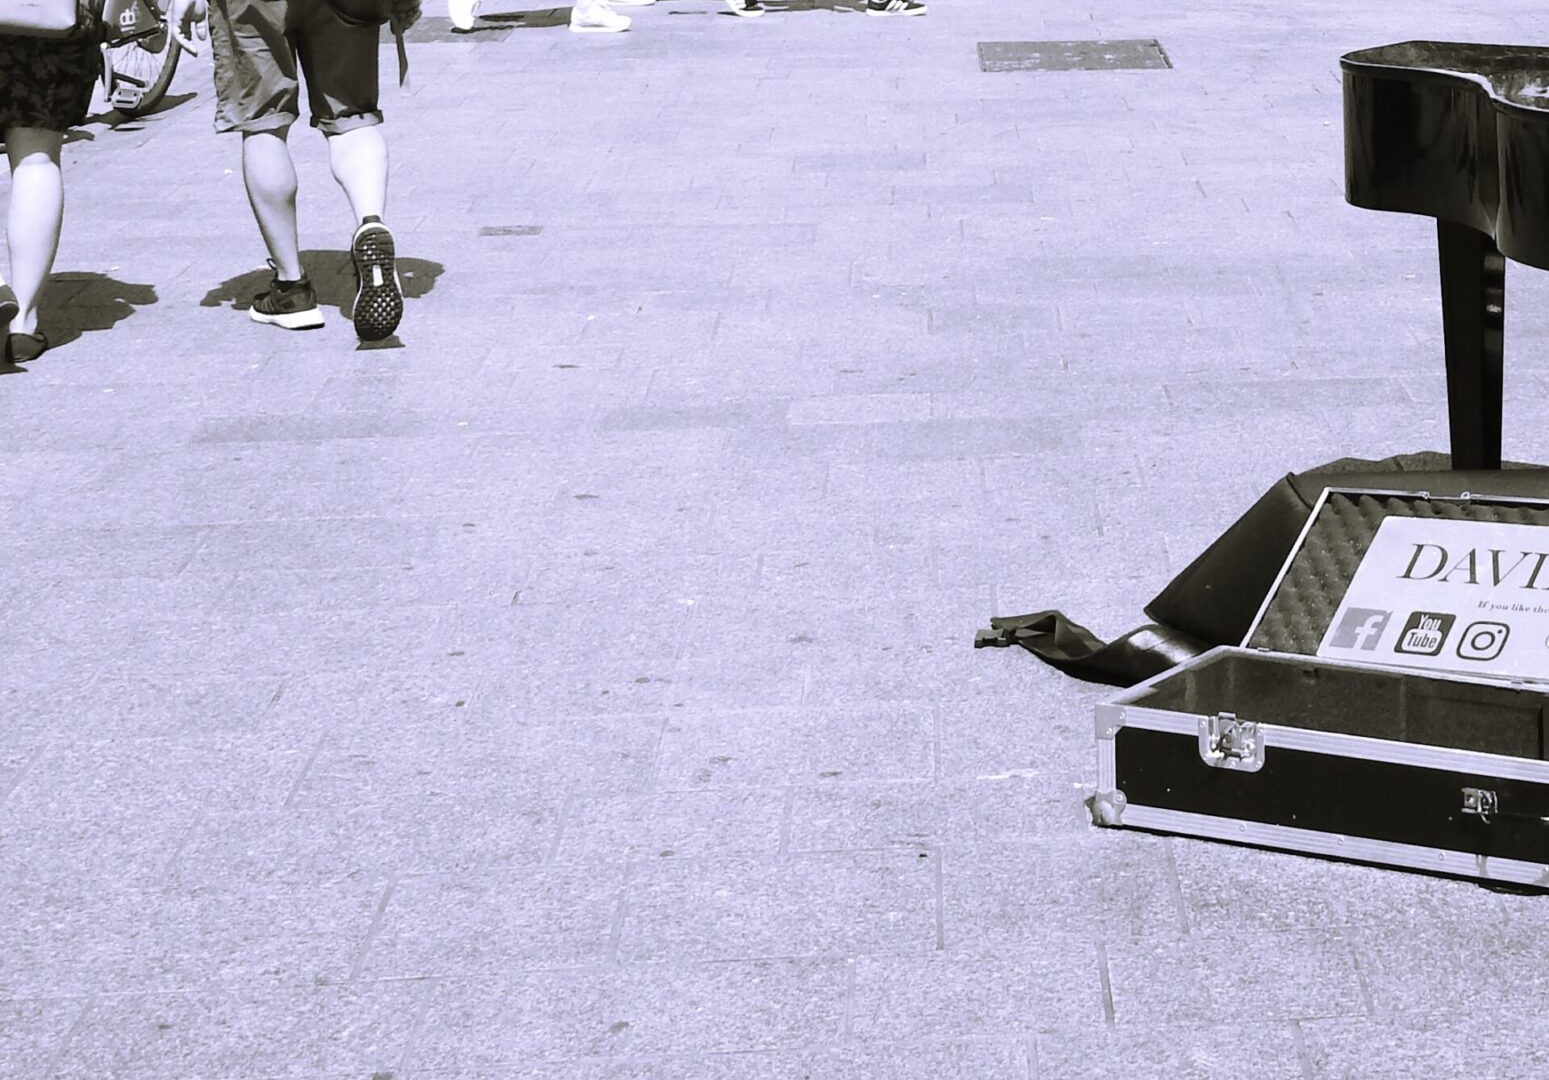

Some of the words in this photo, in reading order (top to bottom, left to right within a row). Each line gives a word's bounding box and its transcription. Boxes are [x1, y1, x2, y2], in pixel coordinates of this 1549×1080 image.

[1478, 600, 1489, 610] If
[1488, 603, 1509, 613] you
[1511, 603, 1531, 613] like
[1533, 605, 1549, 614] the
[1418, 613, 1442, 631] You
[1407, 631, 1438, 649] Tube
